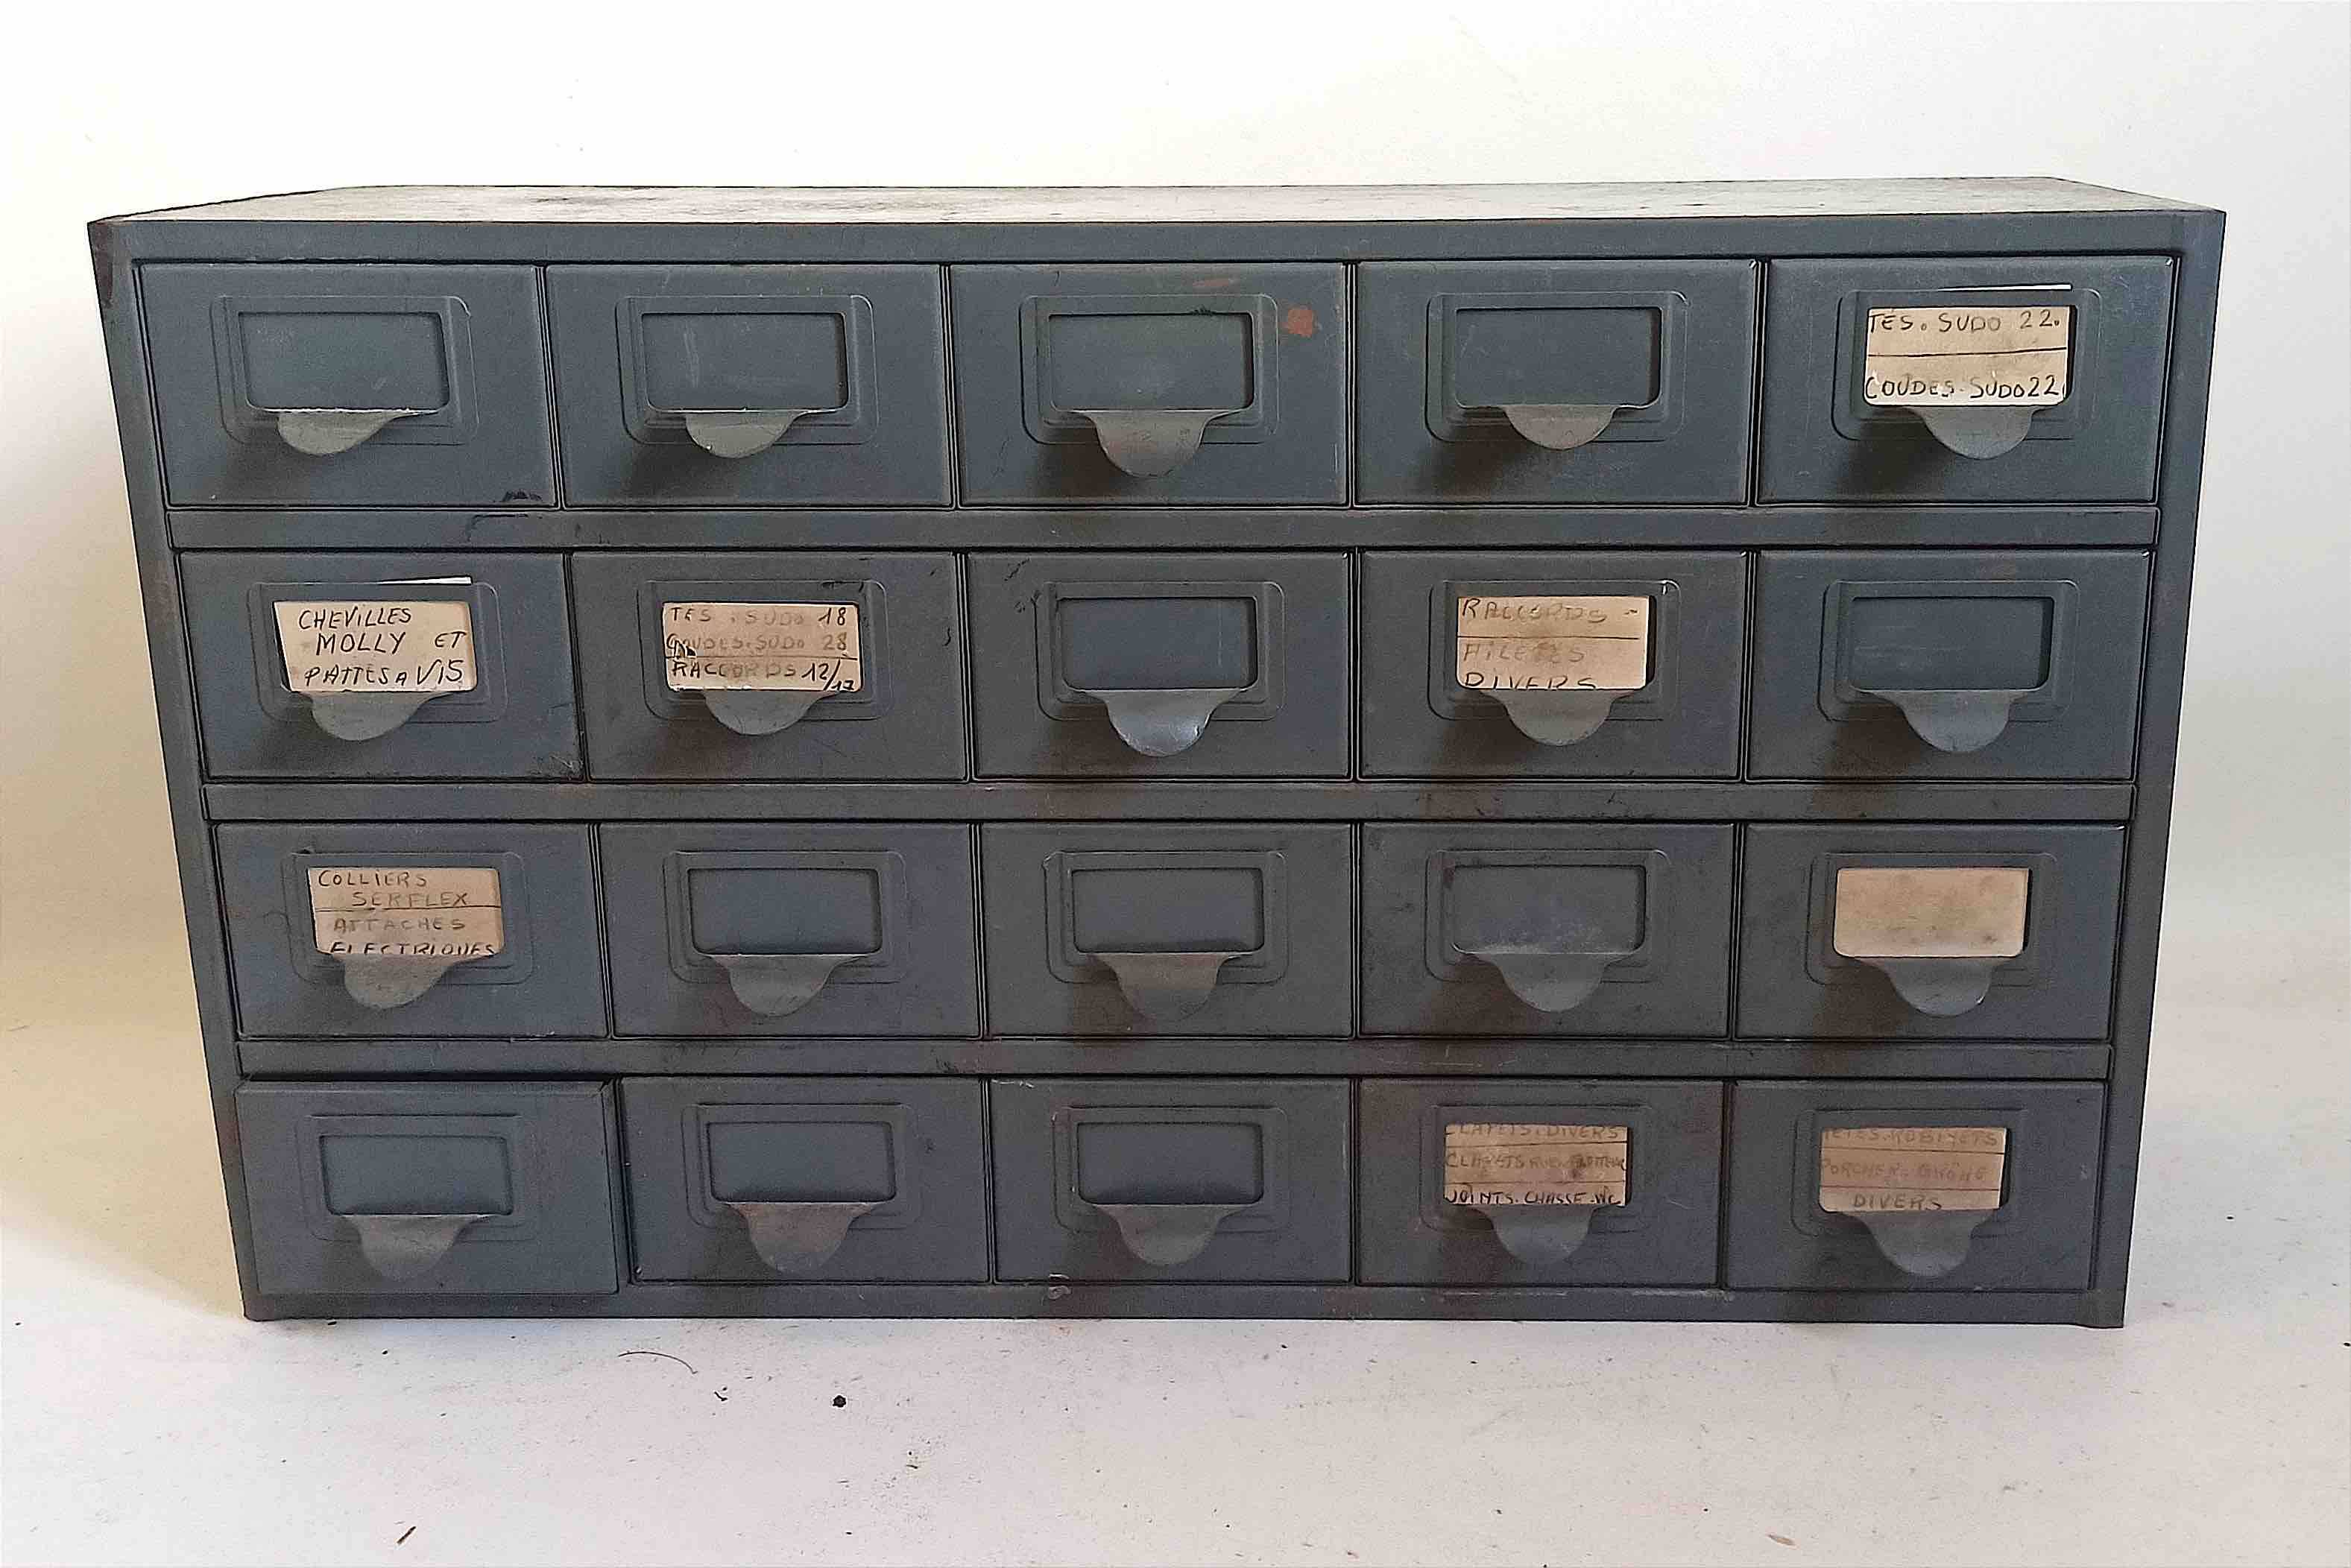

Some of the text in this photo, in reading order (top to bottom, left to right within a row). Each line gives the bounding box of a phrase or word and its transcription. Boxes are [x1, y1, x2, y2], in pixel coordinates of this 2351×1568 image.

[1938, 312, 2001, 332] SUDO
[298, 606, 411, 630] CHEVILLES
[818, 606, 848, 626] 18
[316, 630, 467, 656] MOLLY ET
[304, 664, 390, 686] PATTES
[417, 659, 464, 685] VIS
[318, 869, 427, 887] COLLIERS
[334, 917, 466, 933] ATTACHES
